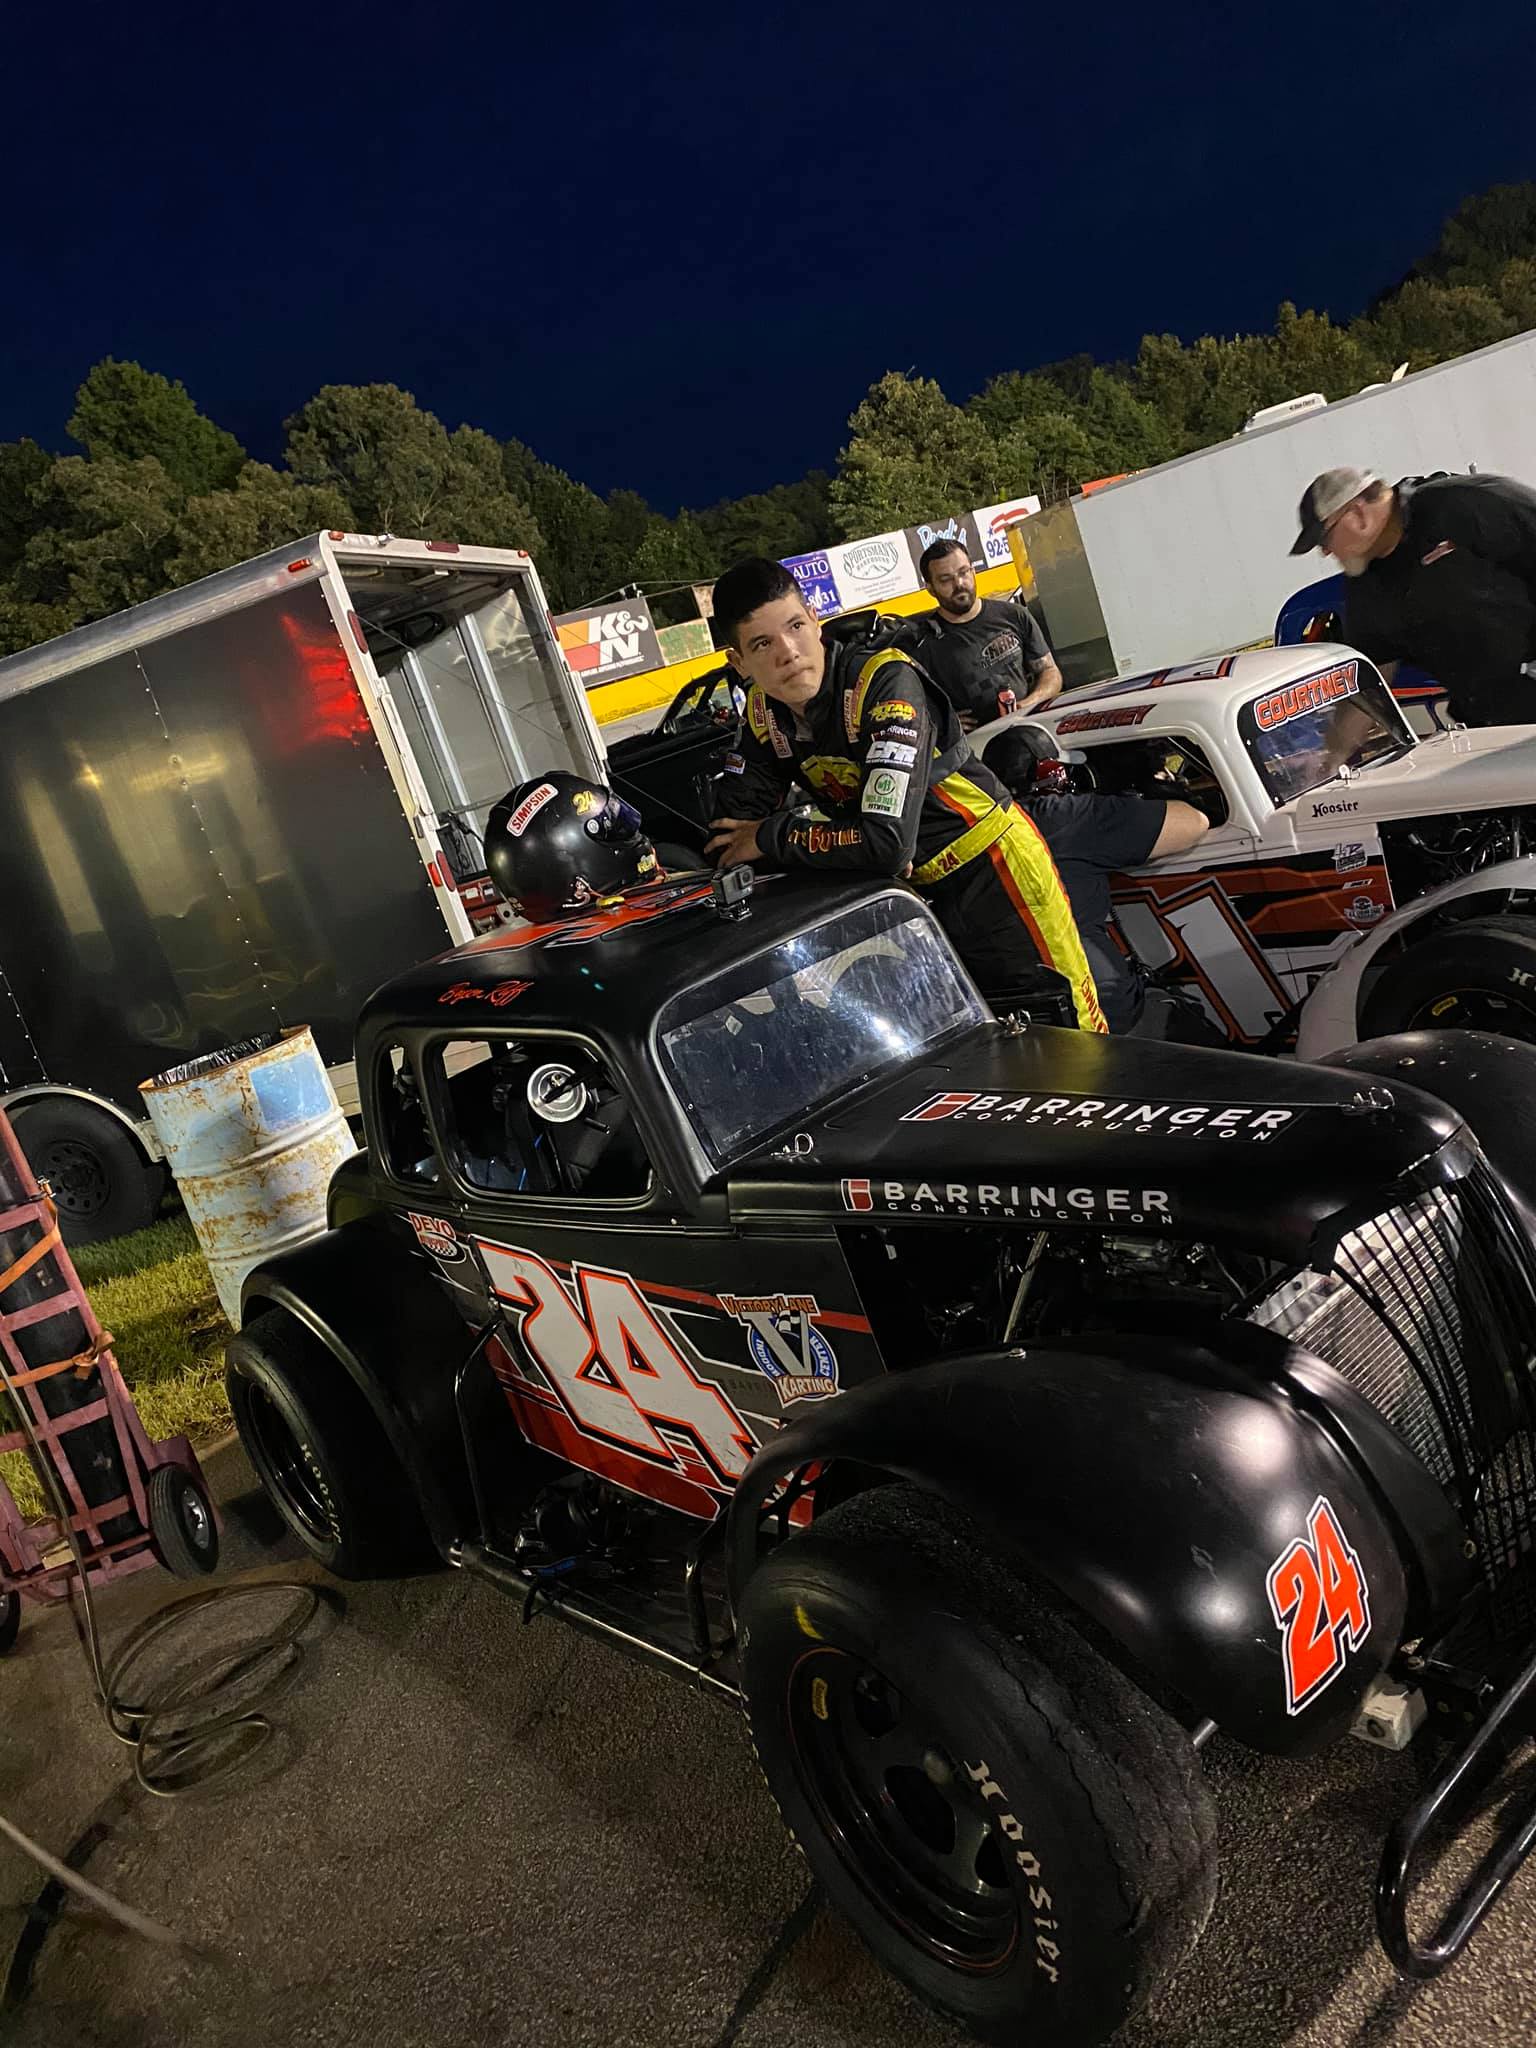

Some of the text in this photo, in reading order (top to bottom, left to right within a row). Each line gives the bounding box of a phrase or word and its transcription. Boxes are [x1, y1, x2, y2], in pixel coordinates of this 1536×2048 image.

[793, 559, 829, 580] AUTO
[843, 541, 899, 574] SPORTSMAN'S
[1256, 663, 1357, 729] COURTNEY
[511, 786, 553, 831] SIMPSON
[572, 790, 597, 816] 24
[1312, 800, 1359, 818] Hoosier
[937, 851, 961, 873] 24
[952, 1111, 1272, 1142] CONSTRUCTION
[968, 1093, 1293, 1130] BARRINGER
[883, 1182, 1170, 1212] BARRINGER
[410, 1213, 455, 1240] DEVO
[886, 1203, 1174, 1225] CONSTRUCTION
[474, 1238, 755, 1482] 24
[755, 1338, 781, 1378] INDOOR
[809, 1335, 831, 1377] CENTER
[779, 1377, 836, 1401] KARTING
[1270, 1499, 1369, 1708] 24
[962, 1759, 1061, 1984] Hoosier
